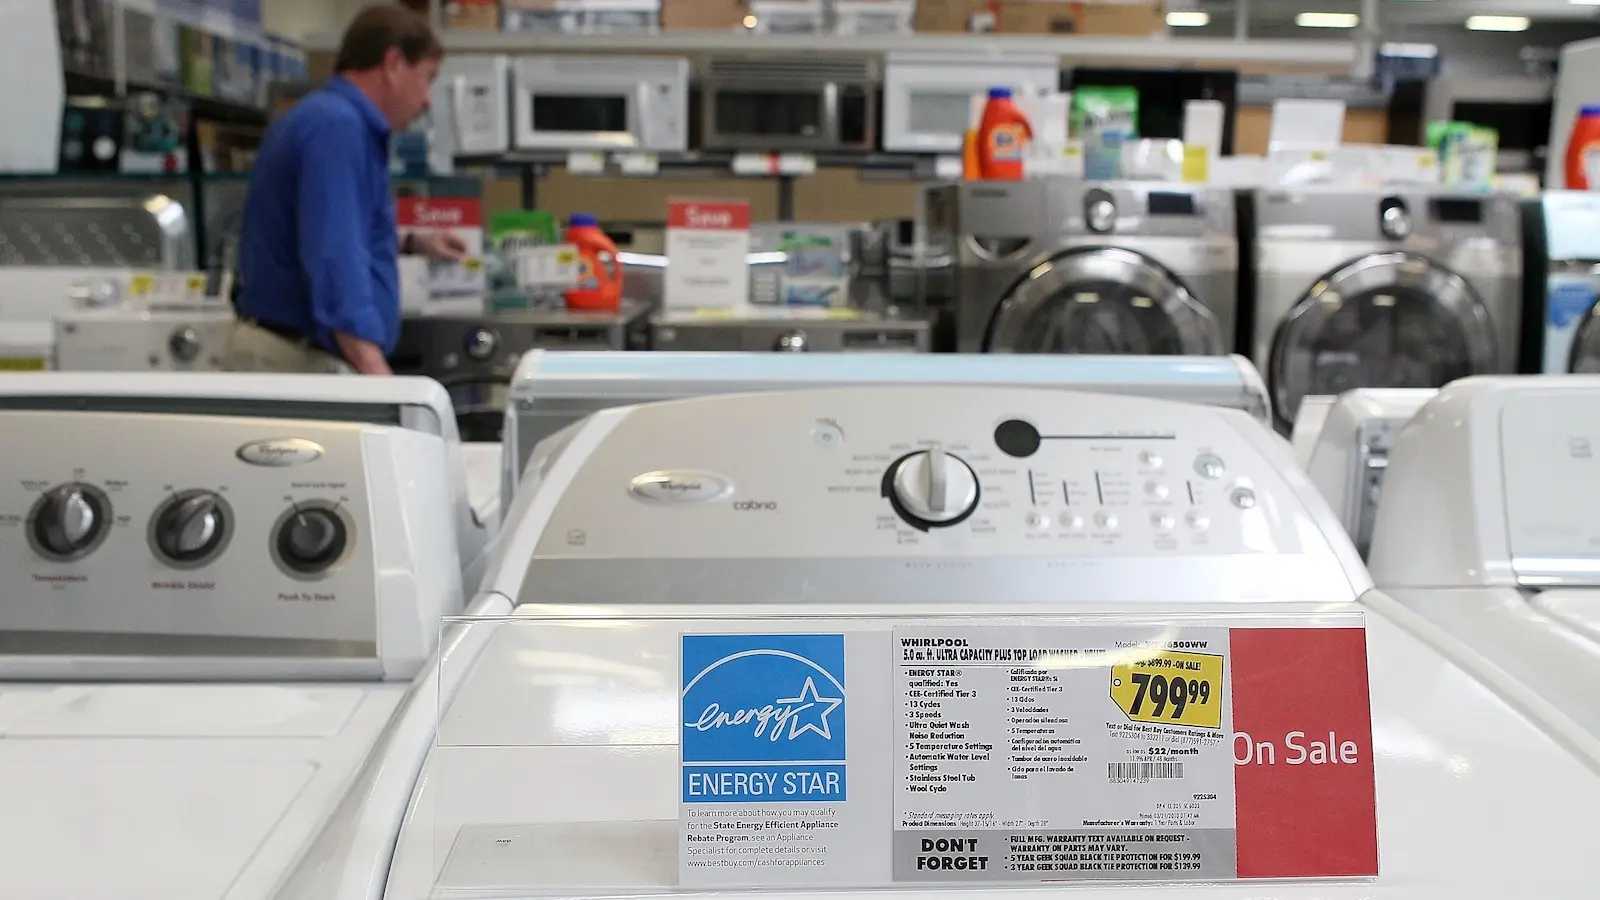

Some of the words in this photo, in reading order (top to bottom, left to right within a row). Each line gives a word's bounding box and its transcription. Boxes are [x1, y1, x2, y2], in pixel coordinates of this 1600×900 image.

[413, 204, 461, 224] Save
[684, 205, 732, 227] Save
[900, 638, 969, 647] WHIRLPOOL
[903, 649, 914, 661] 5.0
[916, 650, 925, 661] cu.
[927, 648, 935, 661] ft.
[937, 649, 958, 661] ULTRA
[960, 649, 993, 661] CAPACITY
[994, 649, 1012, 661] PLUS
[1013, 649, 1027, 661] TOP
[1186, 661, 1201, 670] SALE!
[909, 680, 943, 688] qualified:
[909, 690, 954, 698] CEE-Certified
[956, 690, 970, 698] Tier
[971, 690, 977, 698] 3
[919, 701, 941, 709] Cycles
[916, 711, 942, 719] Speeds
[685, 703, 808, 742] energy
[909, 721, 928, 729] Ultra
[929, 721, 948, 729] Quiet
[949, 721, 970, 729] Wash
[1120, 731, 1140, 740] 9225304
[1147, 733, 1164, 741] 332211
[1163, 727, 1187, 735] Customers
[1188, 730, 1206, 738] Ratings
[915, 743, 964, 751] Temperature
[964, 742, 993, 751] Settings
[1148, 747, 1199, 756] $22/month
[1232, 731, 1276, 765] On
[1285, 731, 1358, 765] Sale
[909, 764, 938, 772] Settings
[690, 772, 777, 795] ENERGY
[783, 772, 840, 795] STAR
[929, 785, 947, 793] Cycle
[688, 809, 696, 817] To
[697, 809, 716, 817] learn
[739, 809, 760, 817] about
[762, 809, 779, 817] how
[810, 808, 836, 818] qualify
[908, 811, 935, 819] Standard
[935, 813, 963, 821] messaging
[965, 811, 978, 819] rates
[737, 822, 763, 831] Energy
[766, 821, 799, 829] Efficient
[800, 821, 838, 830] Appliance
[688, 834, 715, 842] Rebate
[716, 834, 750, 843] Program,
[776, 833, 814, 843] Appliance
[921, 838, 978, 852] DON'T
[688, 847, 724, 856] Specialist
[726, 846, 737, 854] for
[739, 846, 774, 855] complete
[775, 846, 800, 854] details
[810, 846, 827, 854] visit
[1011, 853, 1016, 861] 5
[1017, 853, 1035, 861] YEAR
[1036, 853, 1053, 861] GEEK
[1054, 853, 1078, 861] SQUAD
[1080, 853, 1101, 861] BLACK
[1103, 853, 1115, 861] TIE
[1116, 853, 1158, 861] PROTECTION
[1160, 853, 1173, 861] FOR
[1174, 853, 1201, 861] $199.99
[687, 858, 826, 868] www.bestbuy.com/cashforappliances
[917, 857, 988, 870] FORGET
